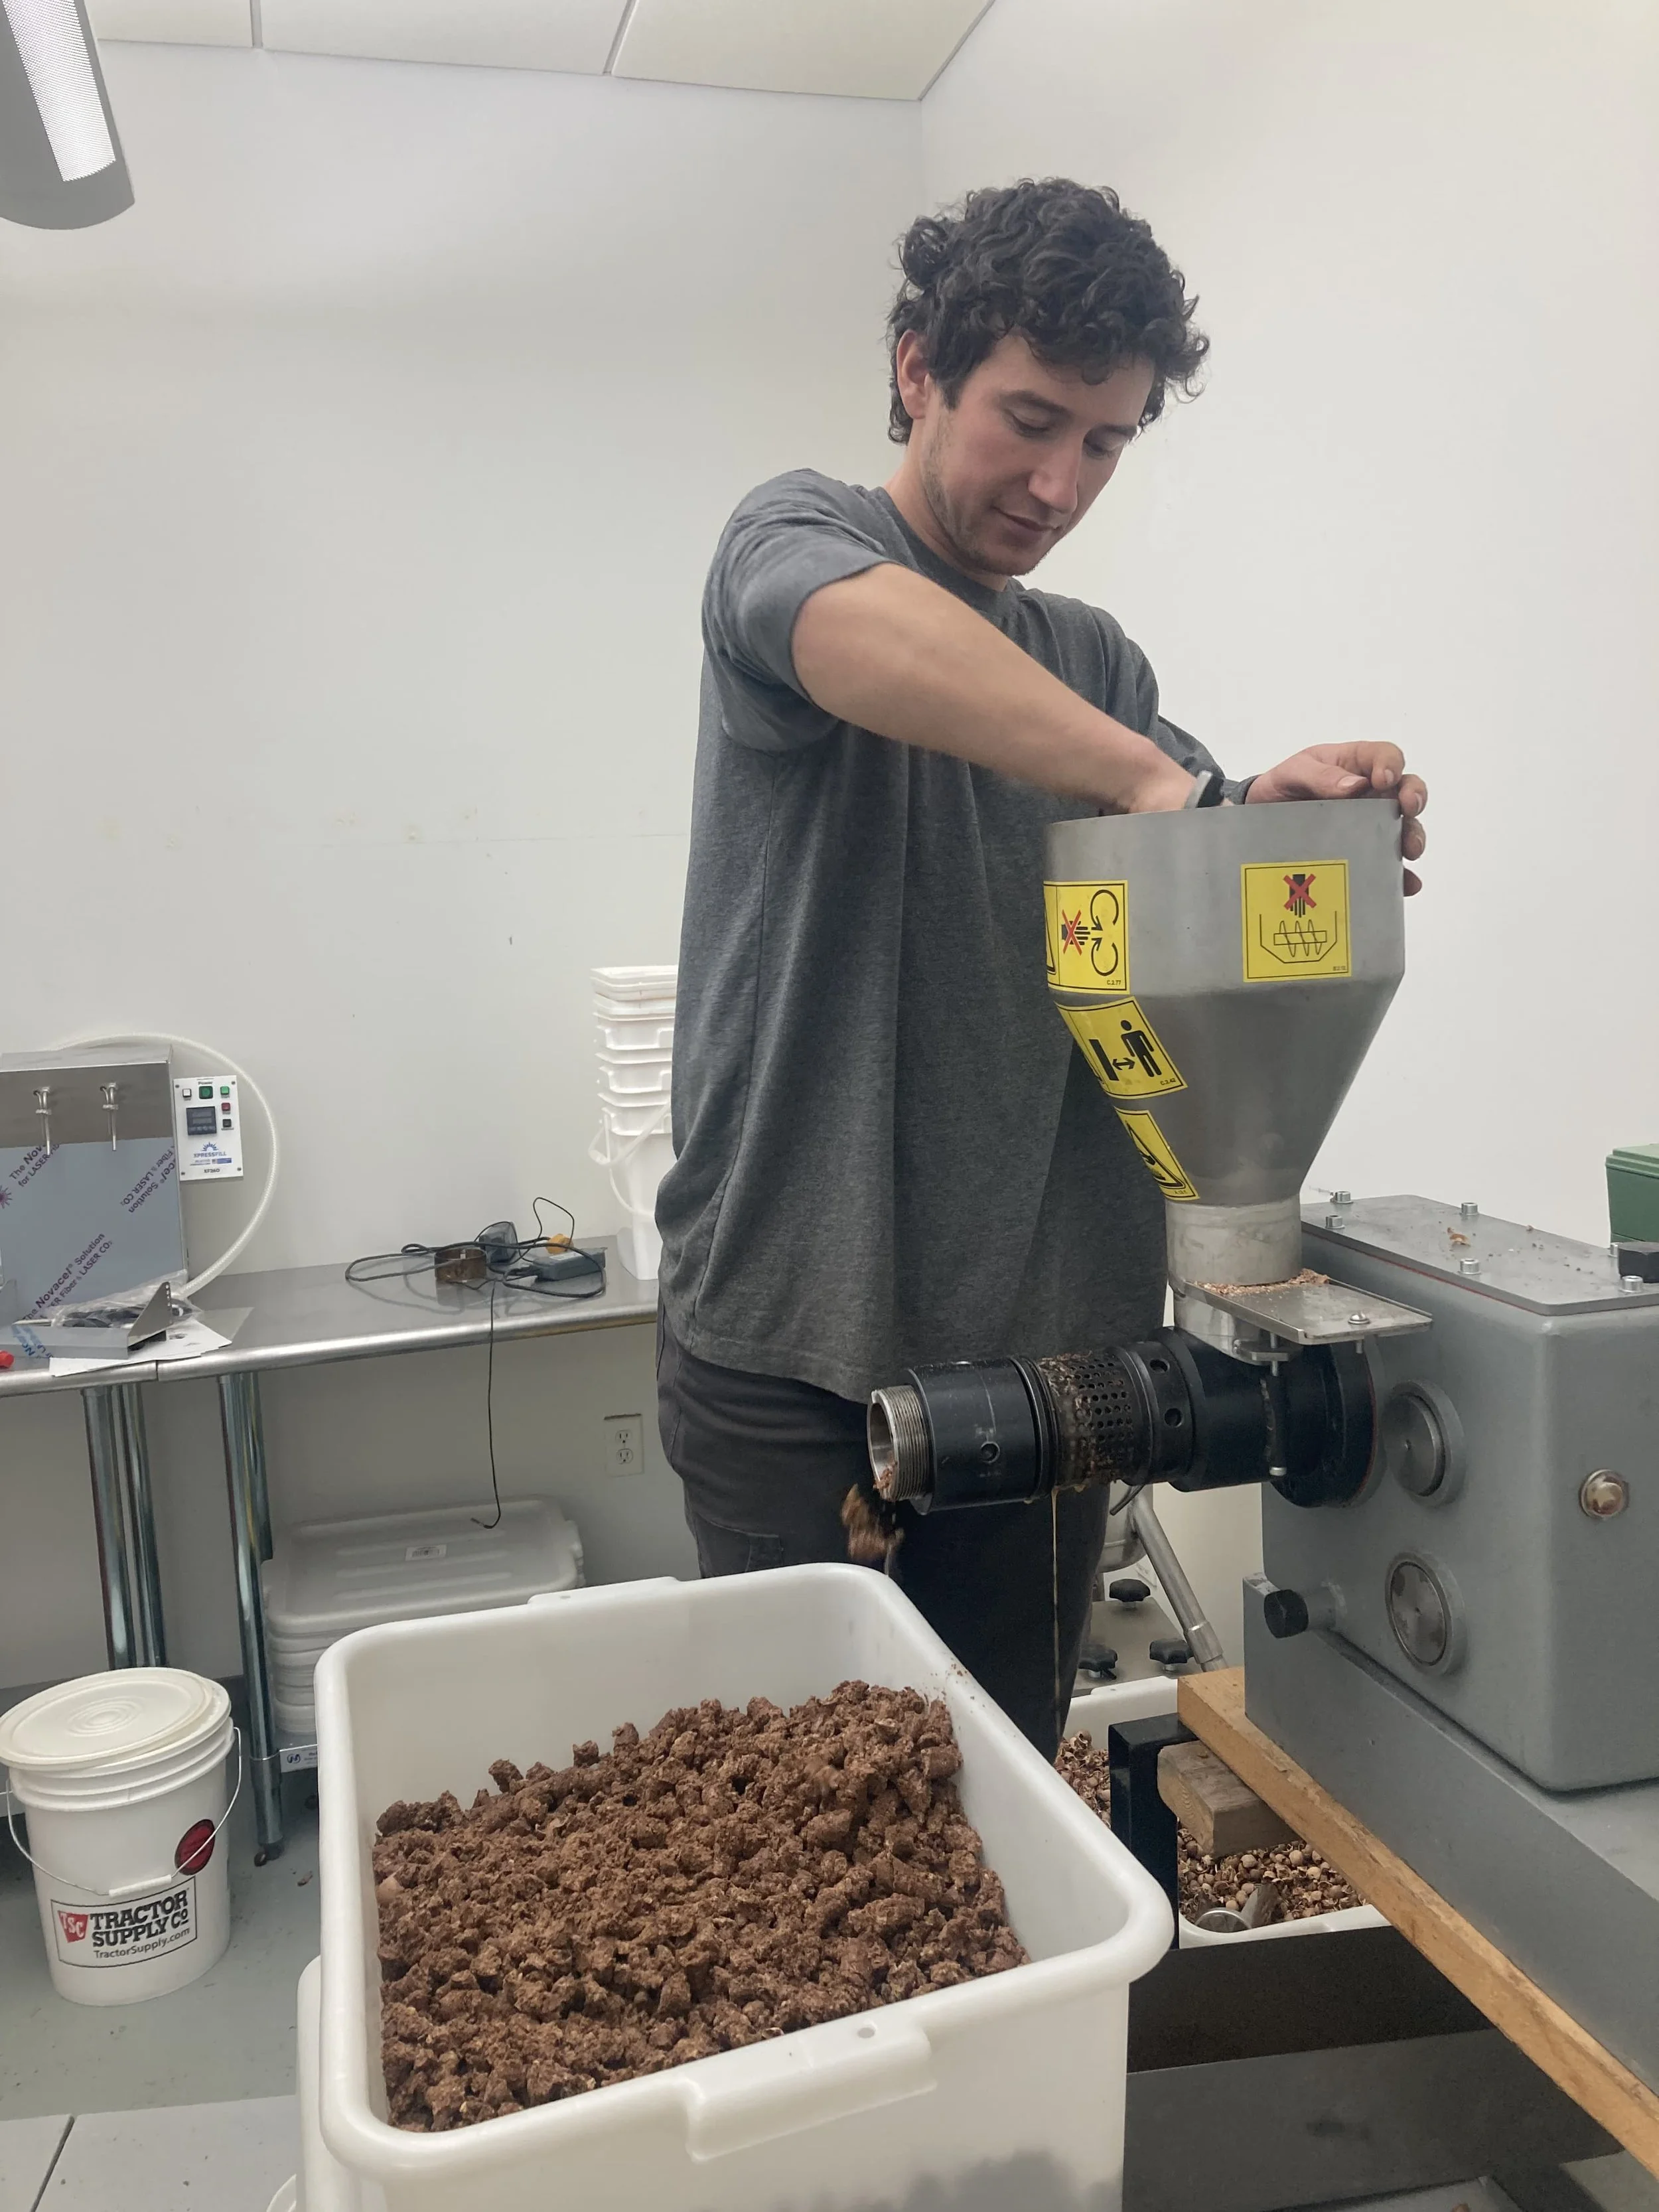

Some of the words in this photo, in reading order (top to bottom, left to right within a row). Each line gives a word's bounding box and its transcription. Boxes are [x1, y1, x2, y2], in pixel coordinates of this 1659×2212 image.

[9, 1165, 26, 1179] The
[18, 1175, 30, 1187] for
[28, 1153, 51, 1177] LASER
[132, 1171, 154, 1194] LASER
[128, 1182, 159, 1213] Solution
[74, 1233, 105, 1266] Solution
[60, 1279, 77, 1298] Fiber
[79, 1252, 102, 1276] LASER
[60, 1913, 84, 1938] TSC
[90, 1889, 188, 1931] TRACTOR
[92, 1916, 169, 1948] SUPPLY
[94, 1927, 190, 1958] TractorSupply.com
